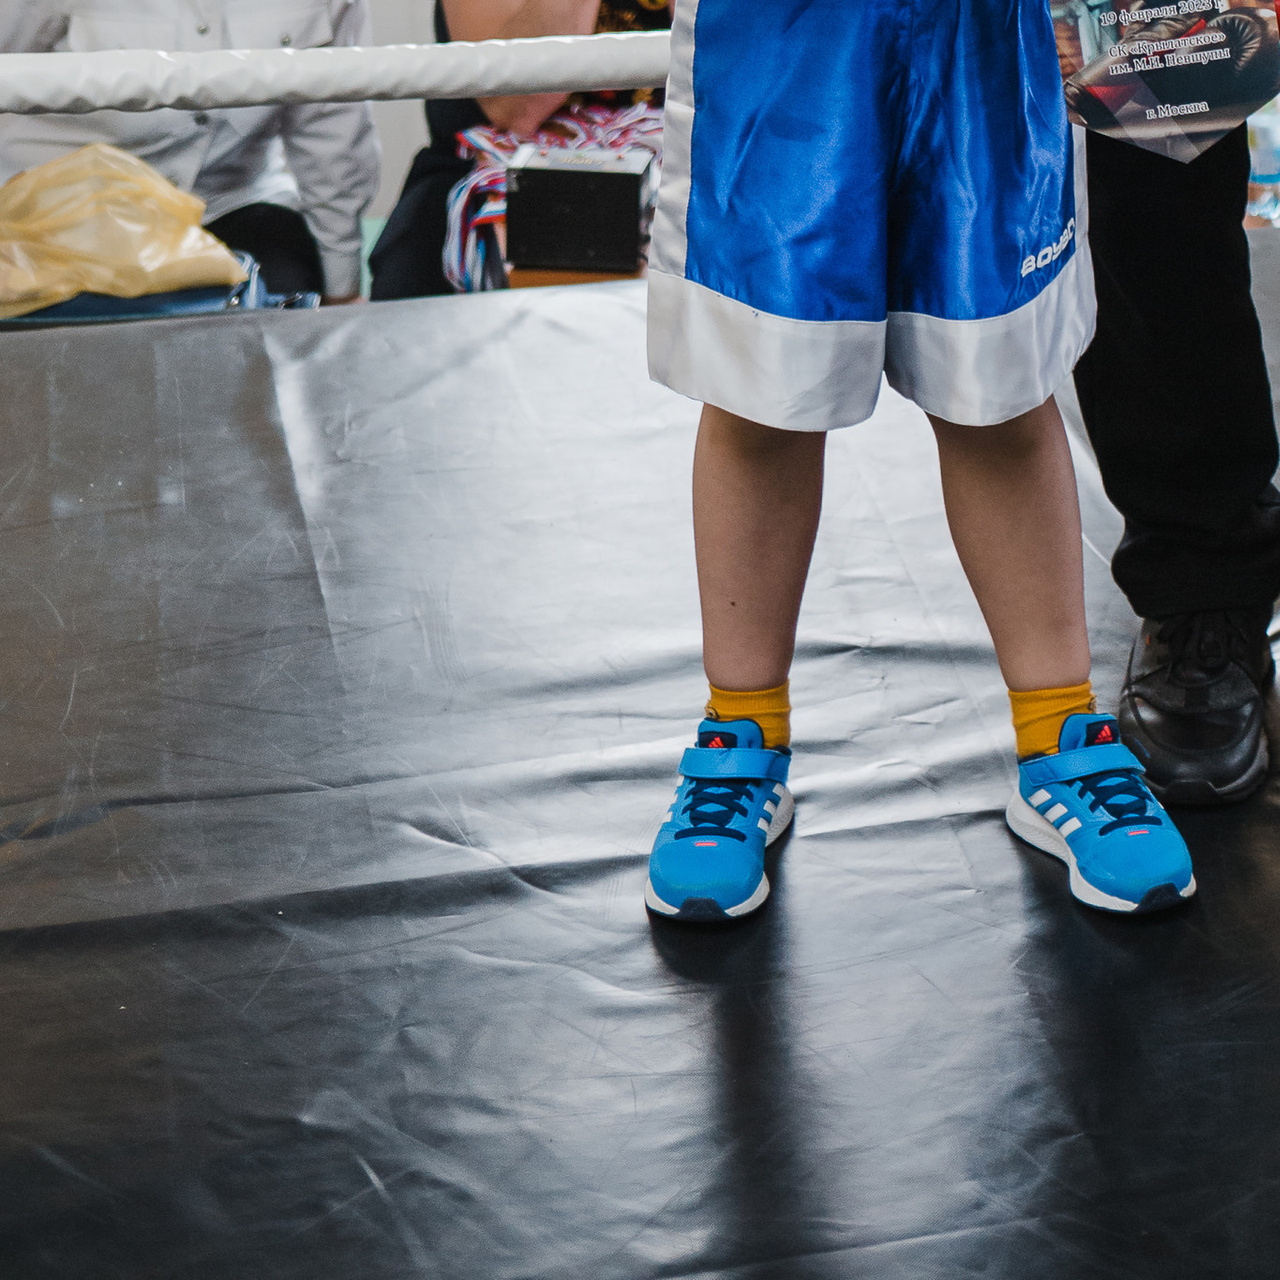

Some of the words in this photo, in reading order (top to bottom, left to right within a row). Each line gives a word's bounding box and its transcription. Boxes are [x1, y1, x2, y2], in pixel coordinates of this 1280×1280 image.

[1099, 12, 1117, 26] 19
[1118, 5, 1178, 26] февраля
[1108, 44, 1129, 58] СК
[1129, 32, 1226, 55] «Крылатское»
[1109, 63, 1133, 75] им.
[1146, 108, 1157, 120] г.
[1157, 101, 1210, 118] Москва
